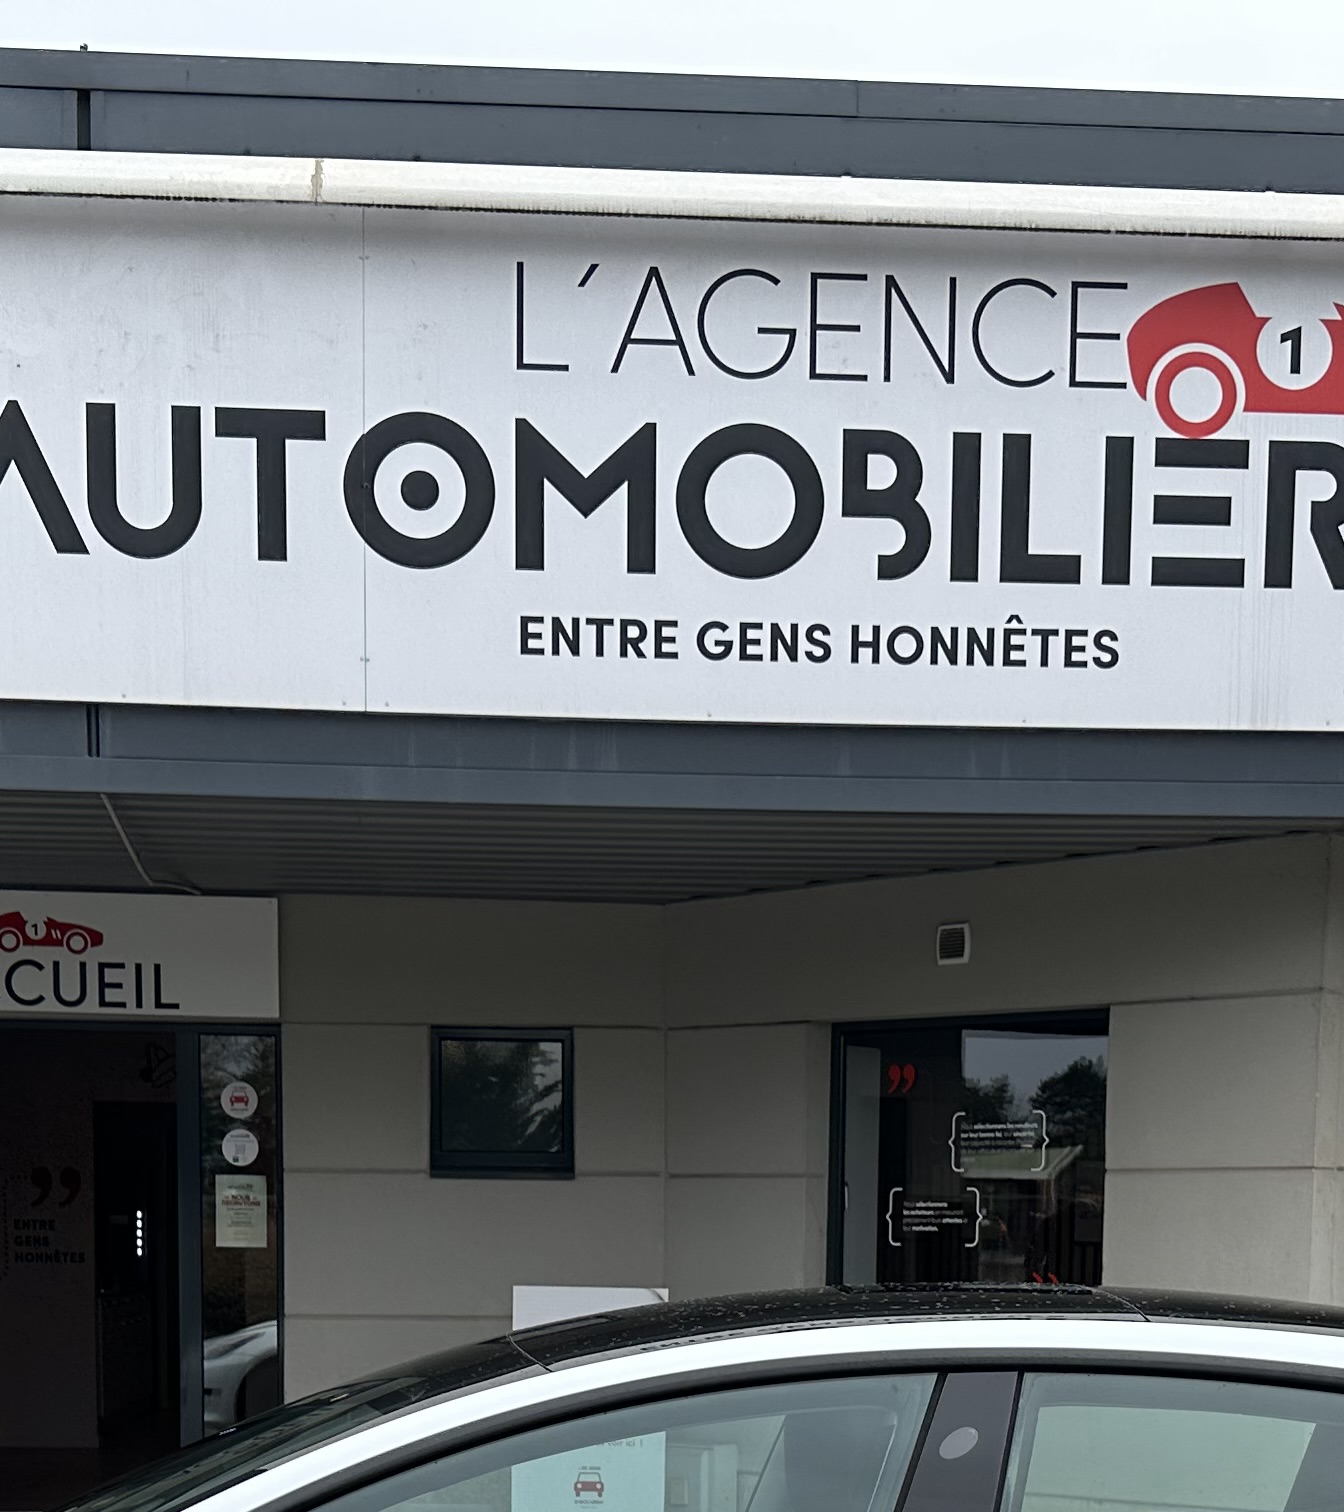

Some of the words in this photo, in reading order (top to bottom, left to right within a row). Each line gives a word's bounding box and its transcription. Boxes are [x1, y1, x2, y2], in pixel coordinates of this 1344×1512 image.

[516, 261, 1129, 390] L'AGENCE
[1279, 325, 1302, 375] 1
[520, 615, 679, 660] ENTRE
[696, 620, 832, 664] GENS
[850, 614, 1119, 669] HONNÊTES
[14, 1219, 56, 1231] ENTRE
[15, 1235, 50, 1247] GENS
[15, 1249, 86, 1264] HONNÊTES
